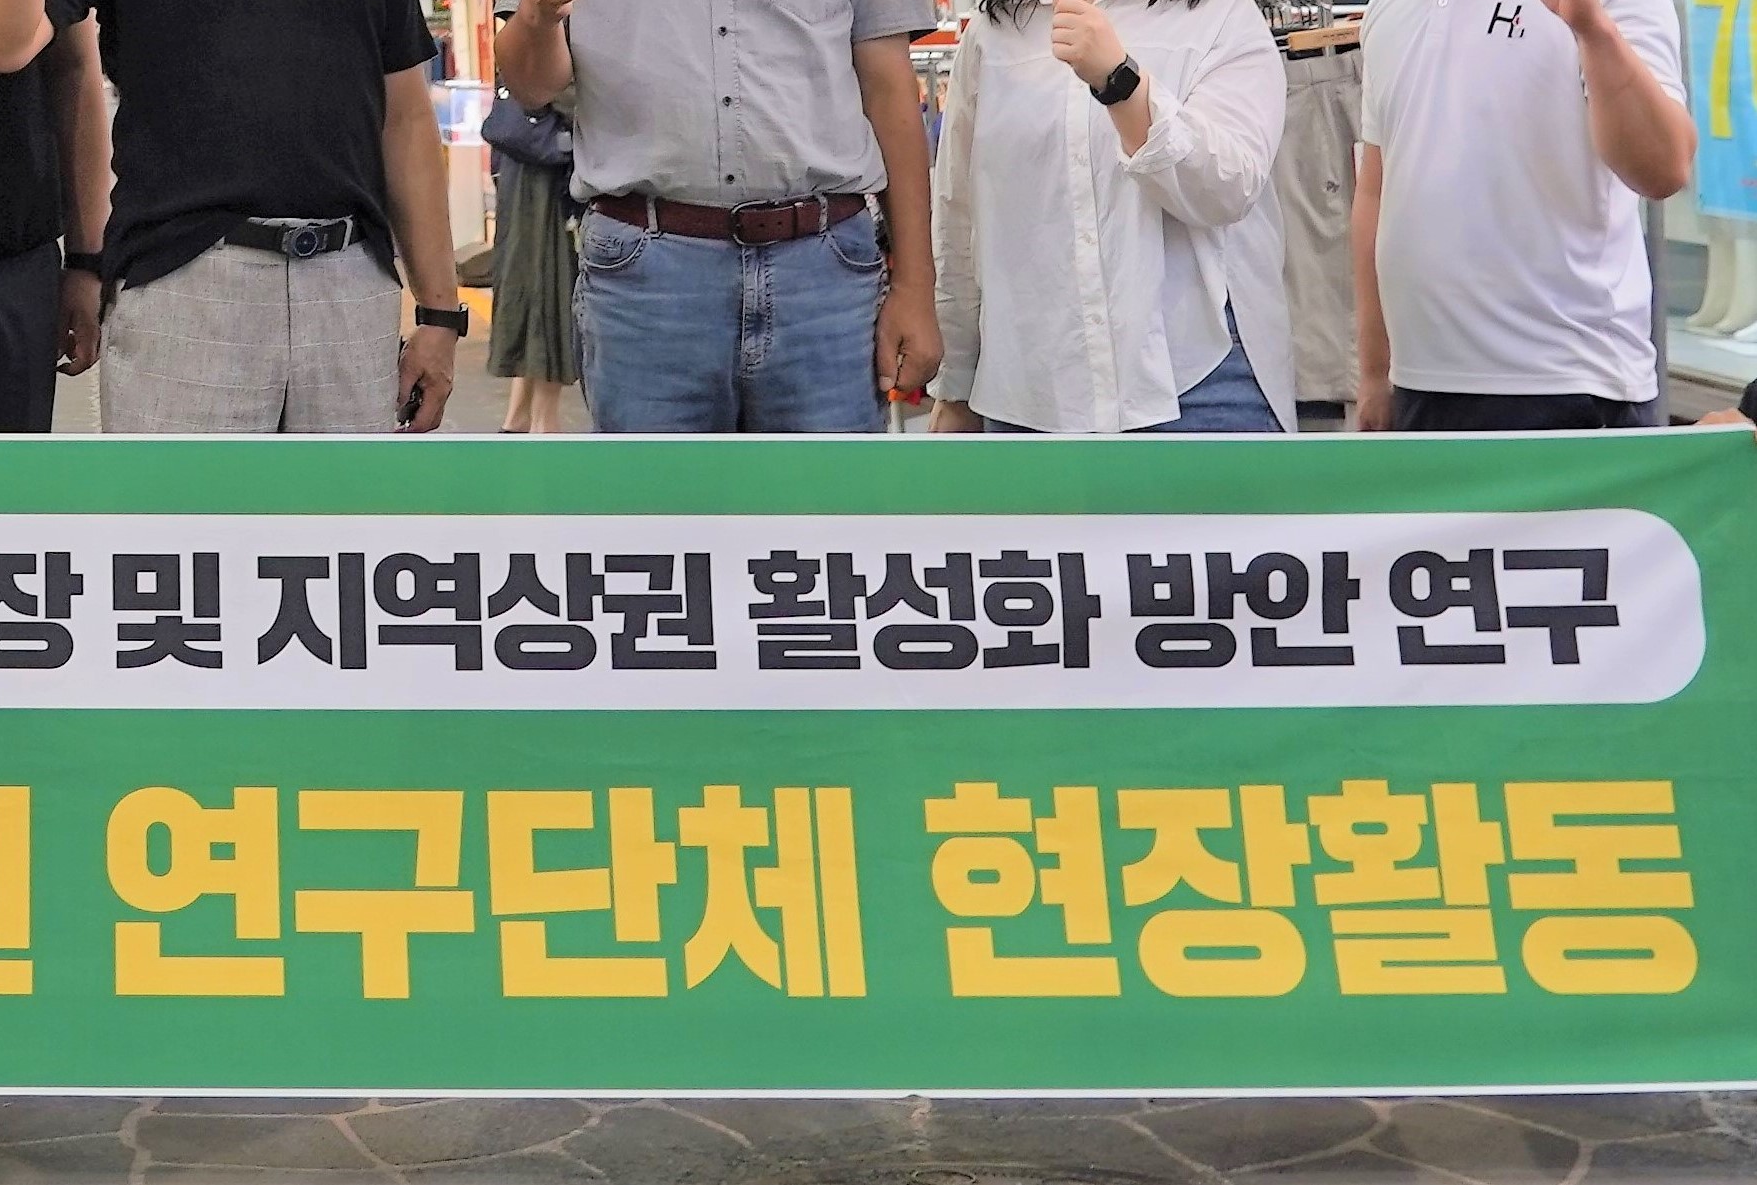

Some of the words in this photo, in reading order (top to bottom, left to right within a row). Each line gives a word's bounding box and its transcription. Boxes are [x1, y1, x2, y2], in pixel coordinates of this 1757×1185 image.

[113, 553, 222, 669] 및
[258, 553, 716, 670] 지역상권
[748, 551, 1101, 670] 활성화
[1127, 552, 1360, 668] 방안
[1389, 549, 1619, 665] 연구
[107, 786, 865, 998] 연구단체
[925, 780, 1696, 996] 현장활동
